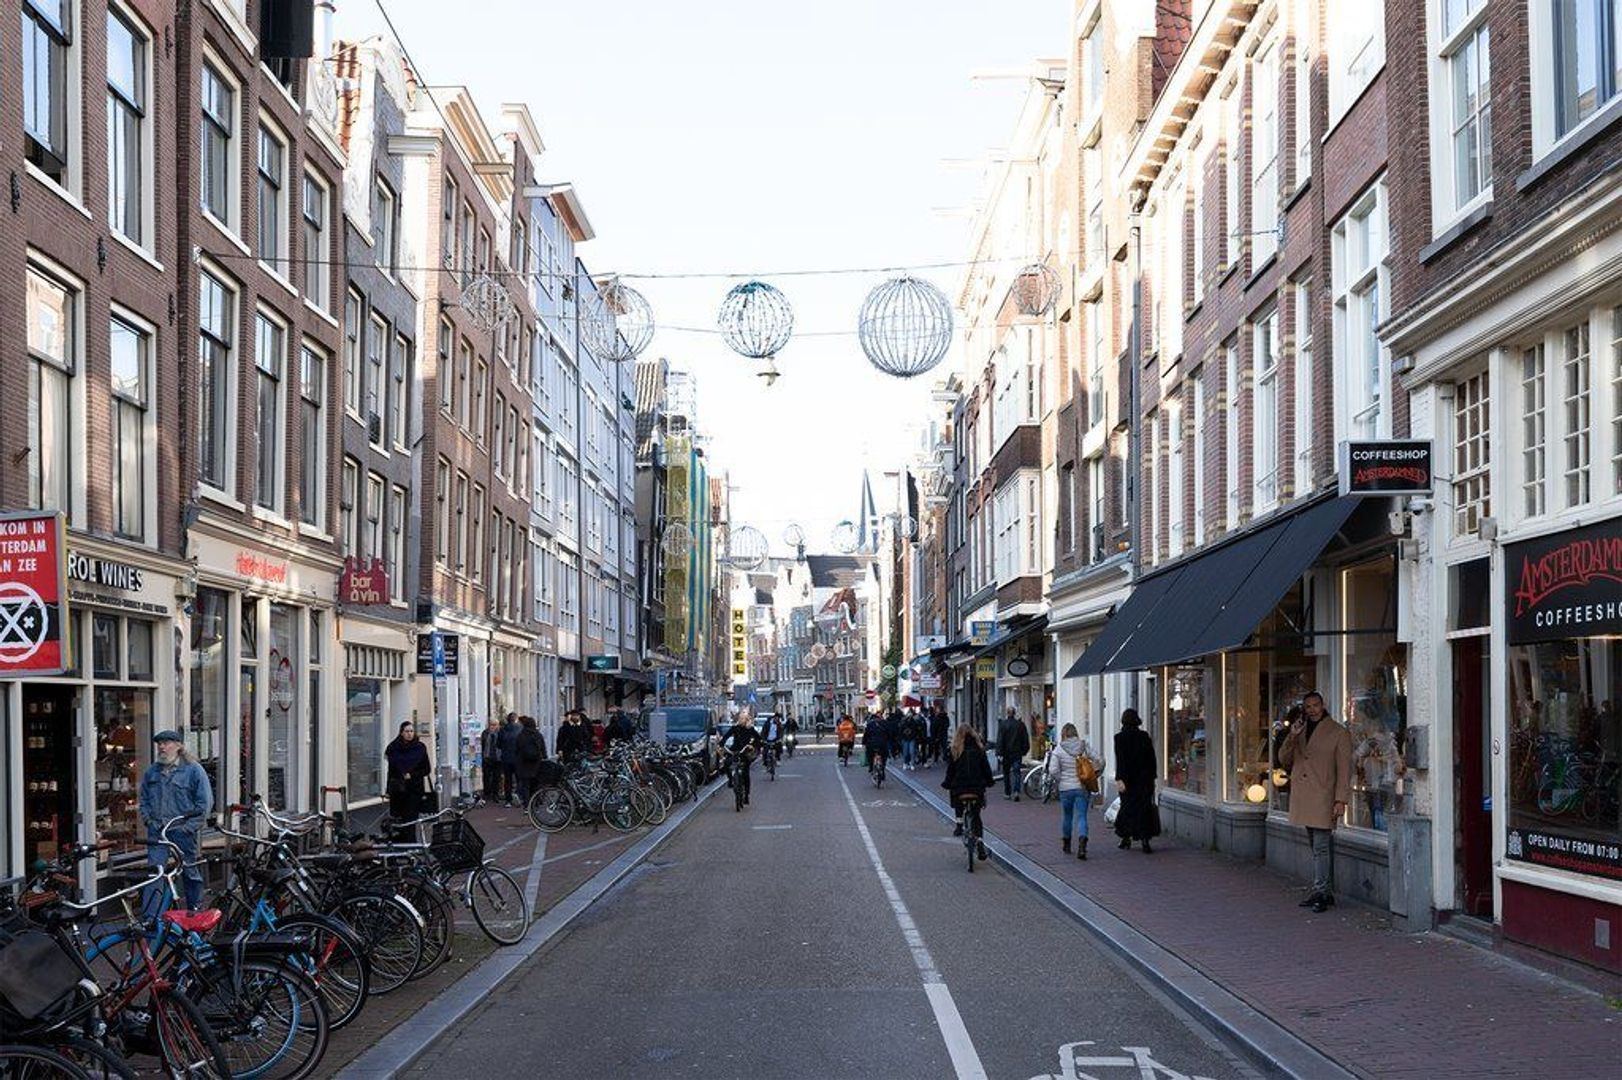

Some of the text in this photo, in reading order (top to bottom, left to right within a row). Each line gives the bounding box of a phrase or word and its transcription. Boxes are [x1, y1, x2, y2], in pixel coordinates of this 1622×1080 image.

[1352, 450, 1428, 461] COFFEESHOP
[33, 521, 45, 534] IN
[18, 558, 37, 572] ZEE
[101, 561, 144, 592] WINES
[350, 573, 373, 587] bar
[734, 609, 745, 674] HOTEL
[1528, 834, 1619, 860] OPEN DAILY FROM 07:00
